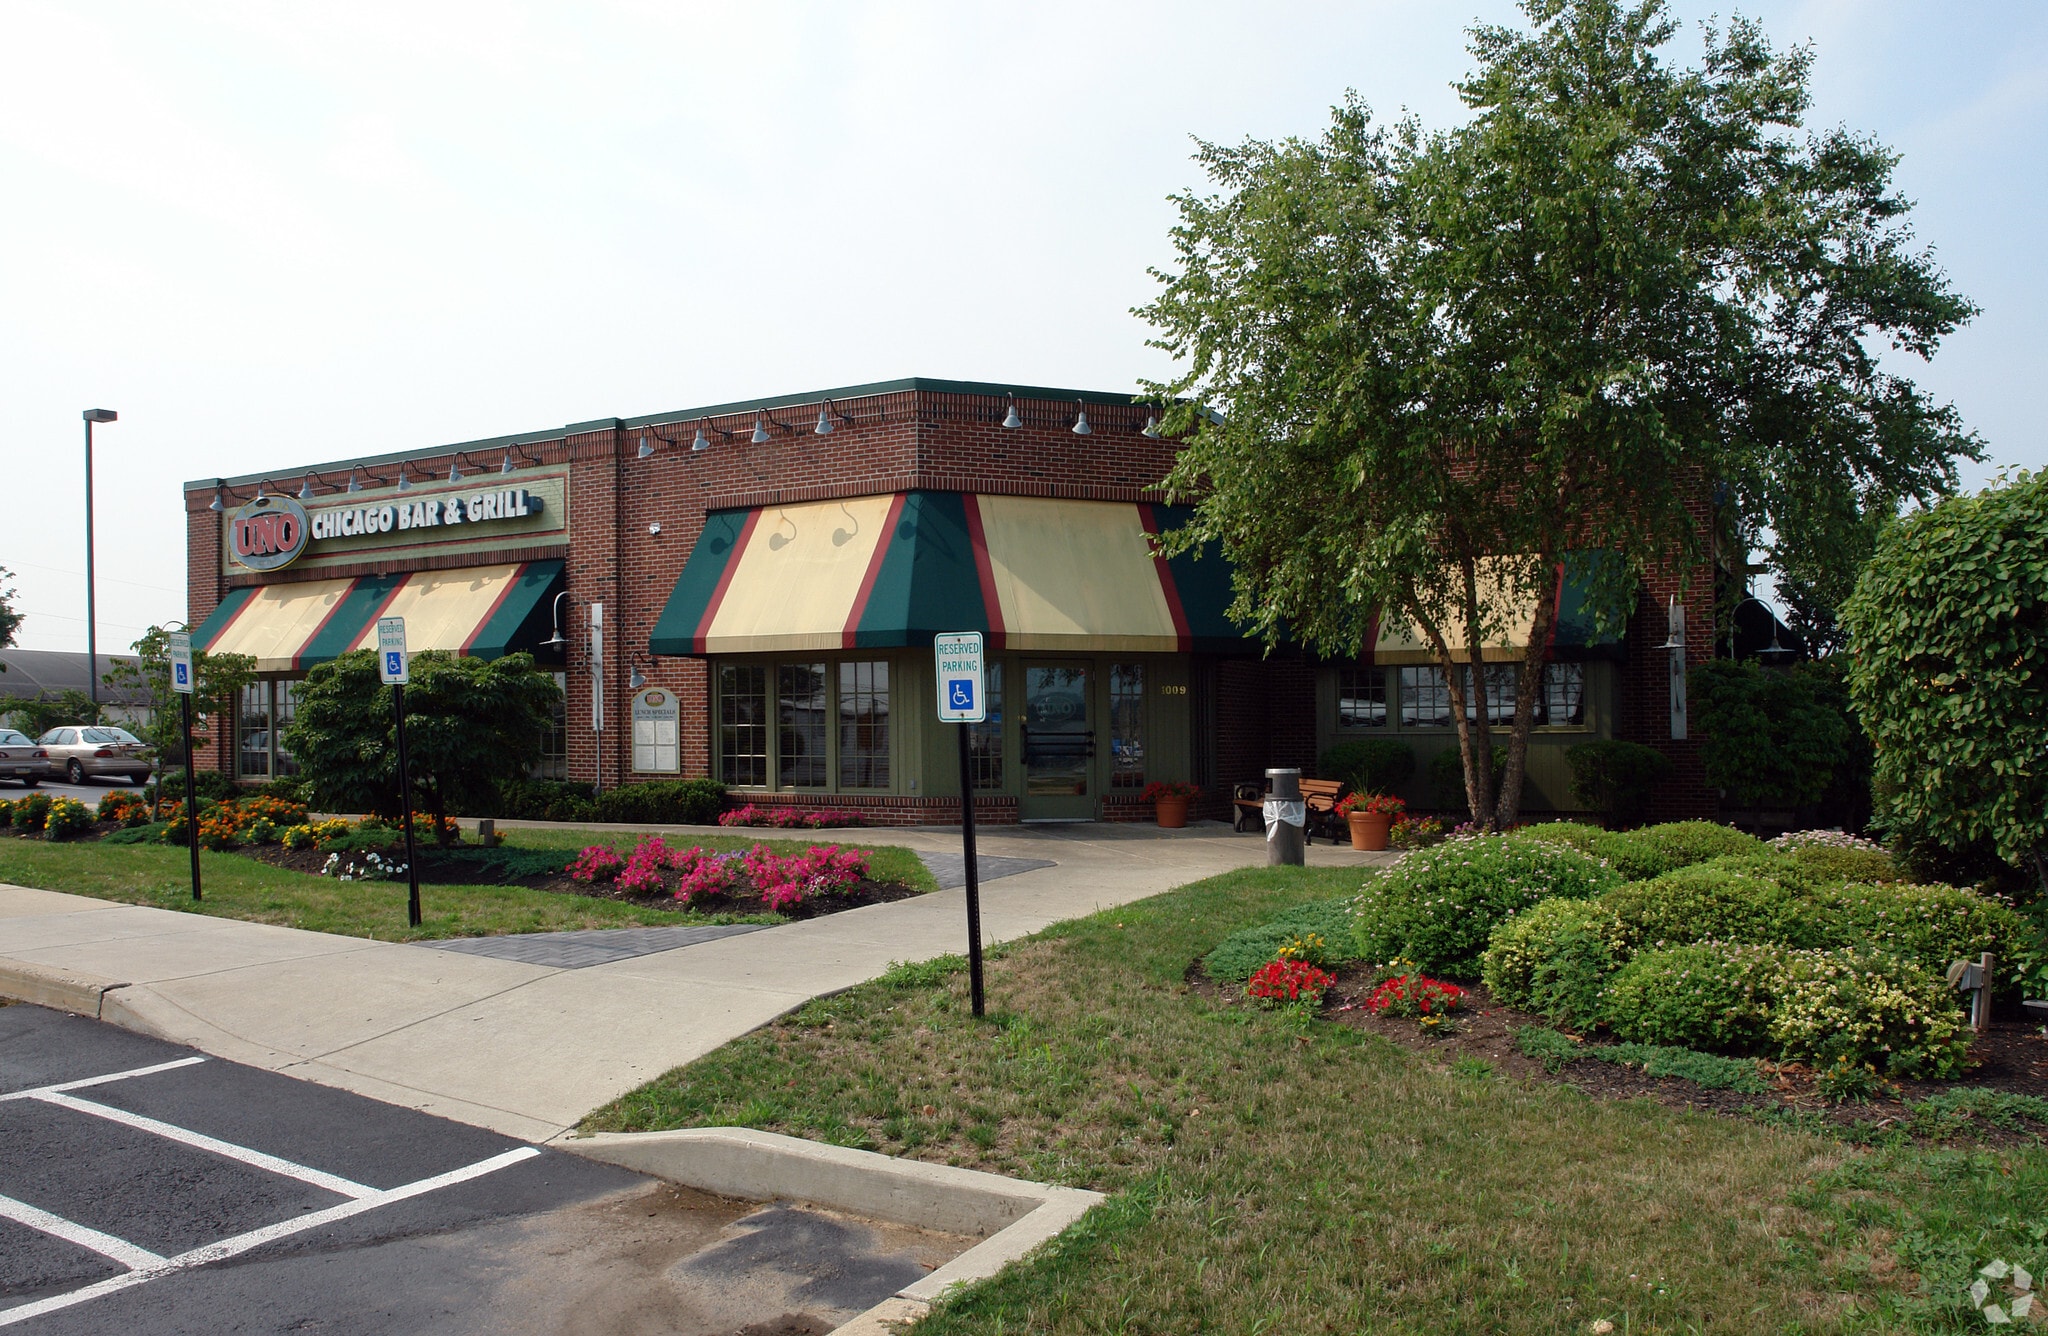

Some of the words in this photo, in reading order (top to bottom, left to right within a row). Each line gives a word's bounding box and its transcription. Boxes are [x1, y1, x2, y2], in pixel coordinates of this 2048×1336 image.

[312, 506, 395, 539] CHICAGO
[398, 501, 440, 530] BAR
[444, 497, 462, 525] &
[467, 489, 528, 522] GRILL
[234, 512, 300, 556] UNO
[379, 624, 404, 634] RESERVED
[382, 637, 403, 647] PARKING
[939, 642, 979, 655] RESERVED
[942, 660, 977, 672] PARKING
